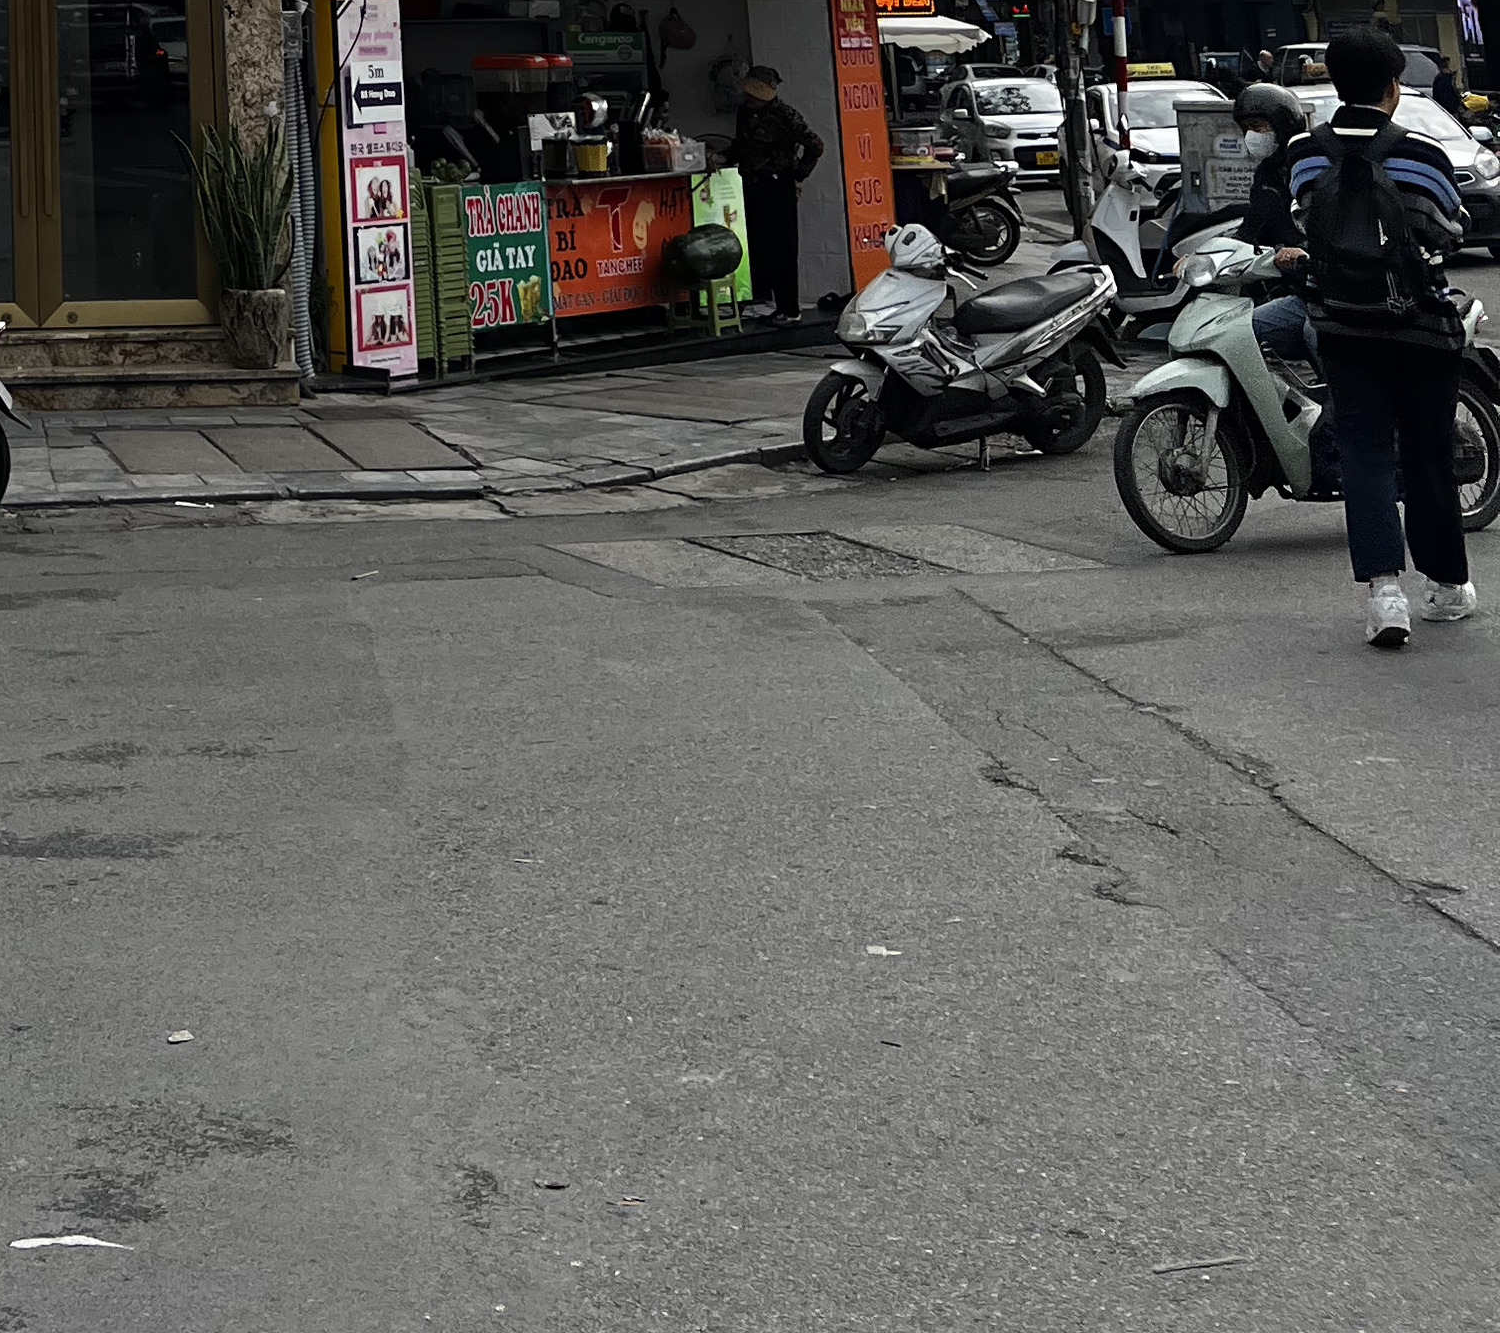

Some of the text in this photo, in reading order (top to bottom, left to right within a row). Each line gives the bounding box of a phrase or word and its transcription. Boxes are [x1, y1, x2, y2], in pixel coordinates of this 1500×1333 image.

[368, 64, 385, 79] 5m
[466, 185, 543, 237] TRÀ CHANH
[556, 223, 577, 252] BÍ
[476, 242, 536, 272] GIÃ TAY
[597, 257, 644, 277] TANCHEE
[470, 278, 516, 330] 25K
